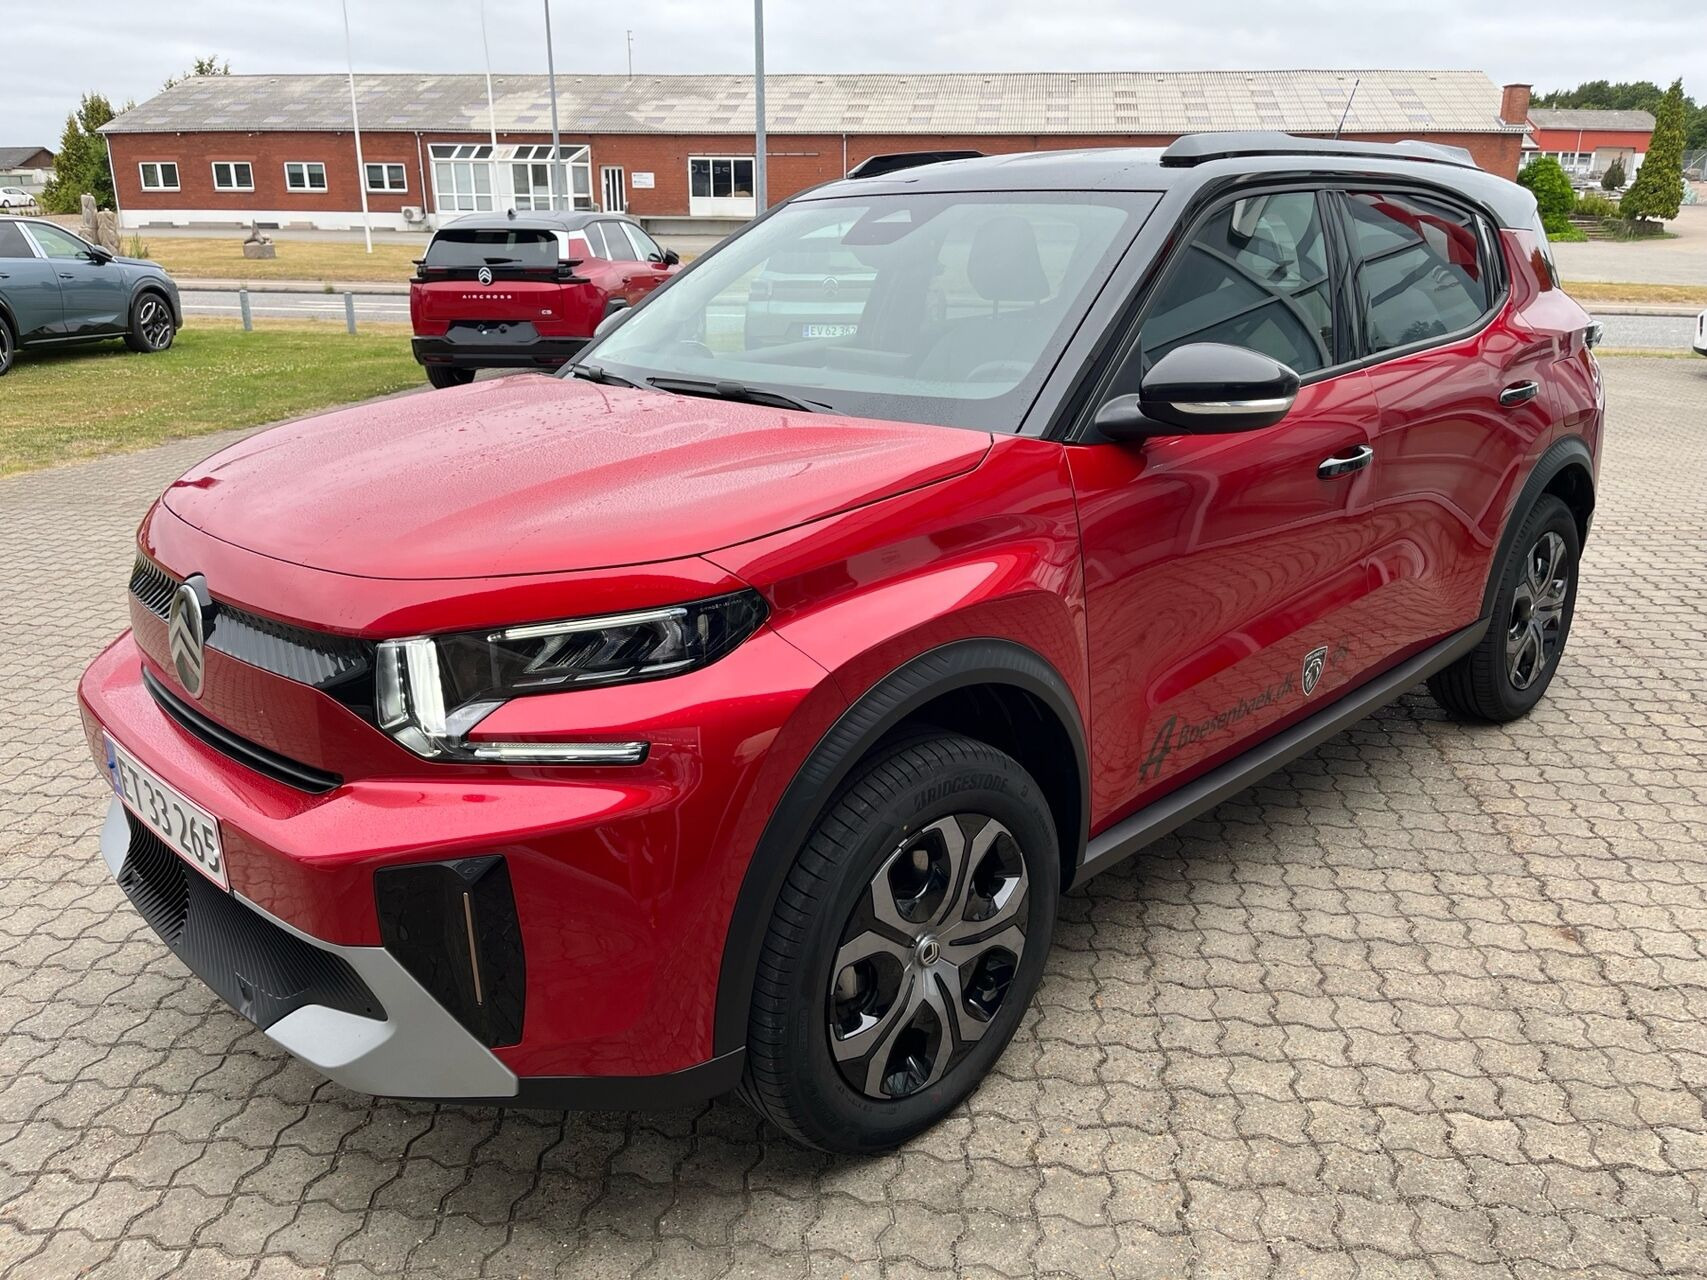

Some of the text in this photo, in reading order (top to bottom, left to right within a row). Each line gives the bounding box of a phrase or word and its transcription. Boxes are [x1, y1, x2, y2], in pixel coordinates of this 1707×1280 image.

[810, 326, 823, 336] EV
[825, 326, 837, 336] 62
[914, 773, 1009, 811] BRIDGESTONE
[117, 755, 220, 873] ET 33 265
